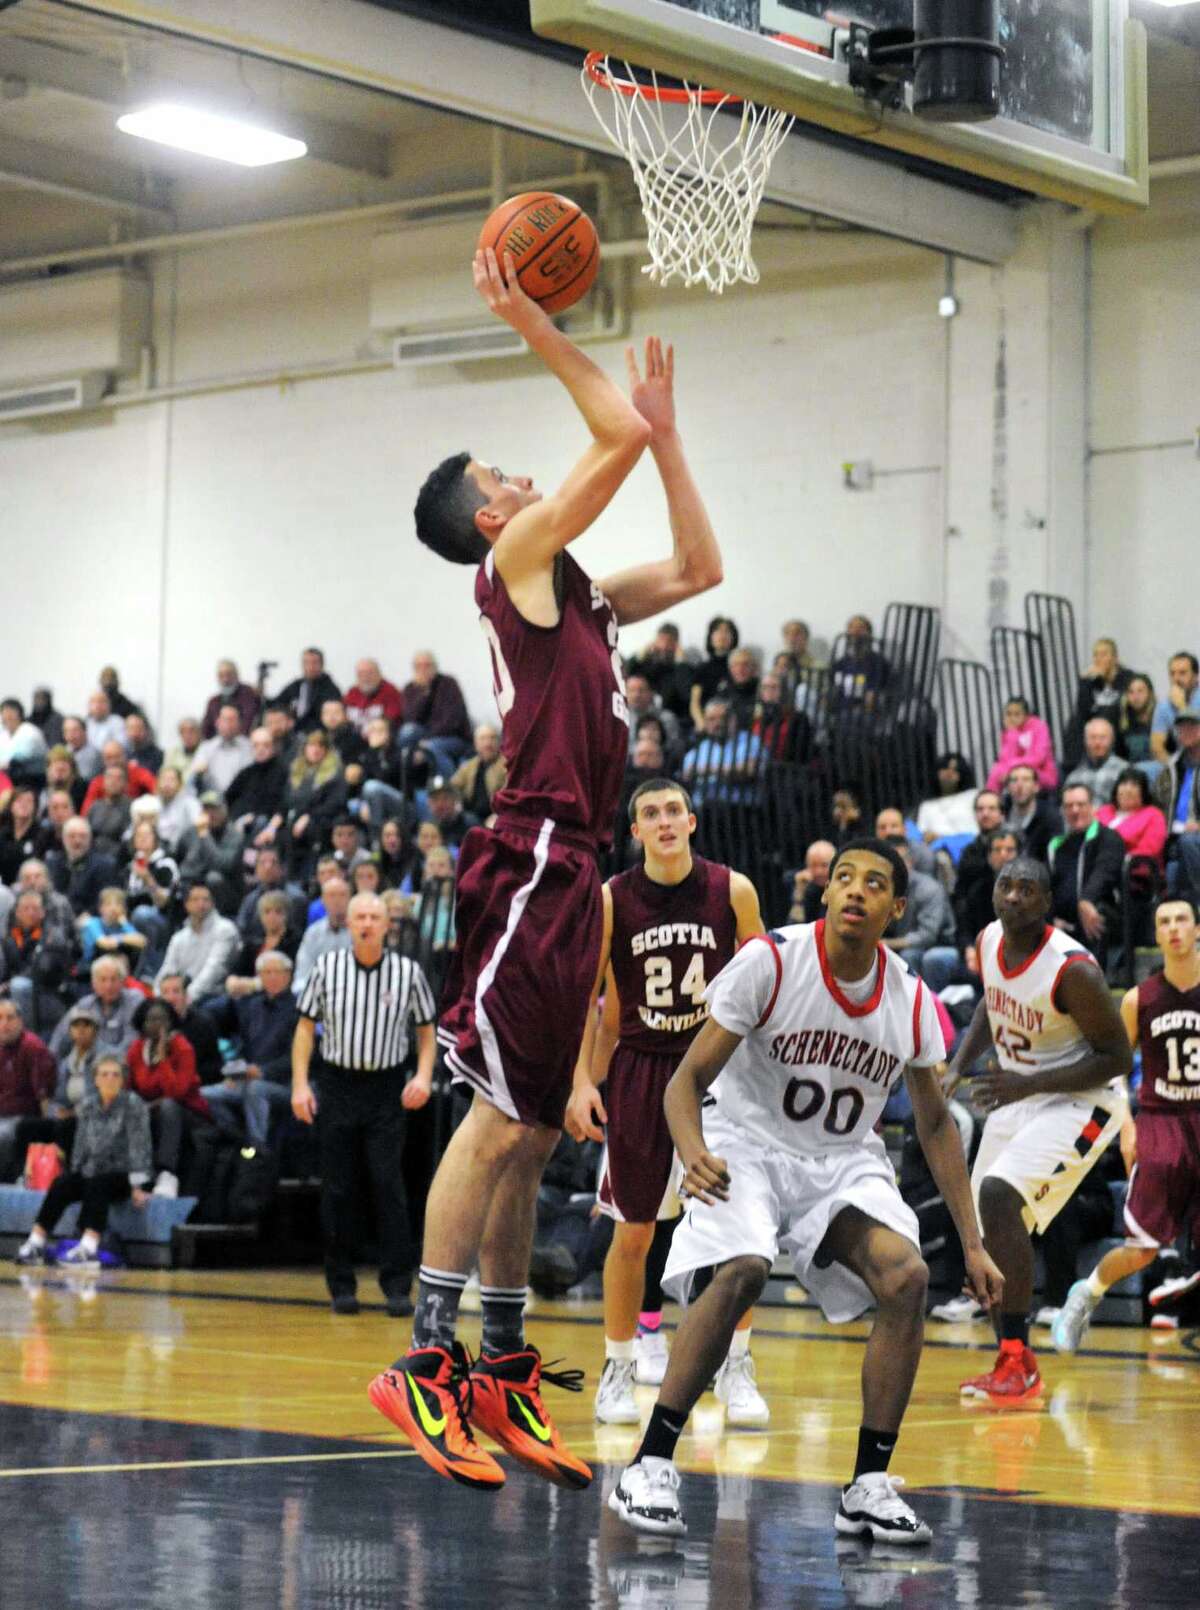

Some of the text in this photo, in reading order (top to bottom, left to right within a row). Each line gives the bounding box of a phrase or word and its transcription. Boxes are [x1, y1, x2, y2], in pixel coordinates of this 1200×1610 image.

[504, 227, 535, 257] HE
[631, 923, 717, 957] SCOTIA
[644, 952, 707, 1008] 24
[769, 1028, 900, 1087] SCHENECTADY
[1165, 1036, 1200, 1082] 13
[783, 1076, 864, 1135] 00
